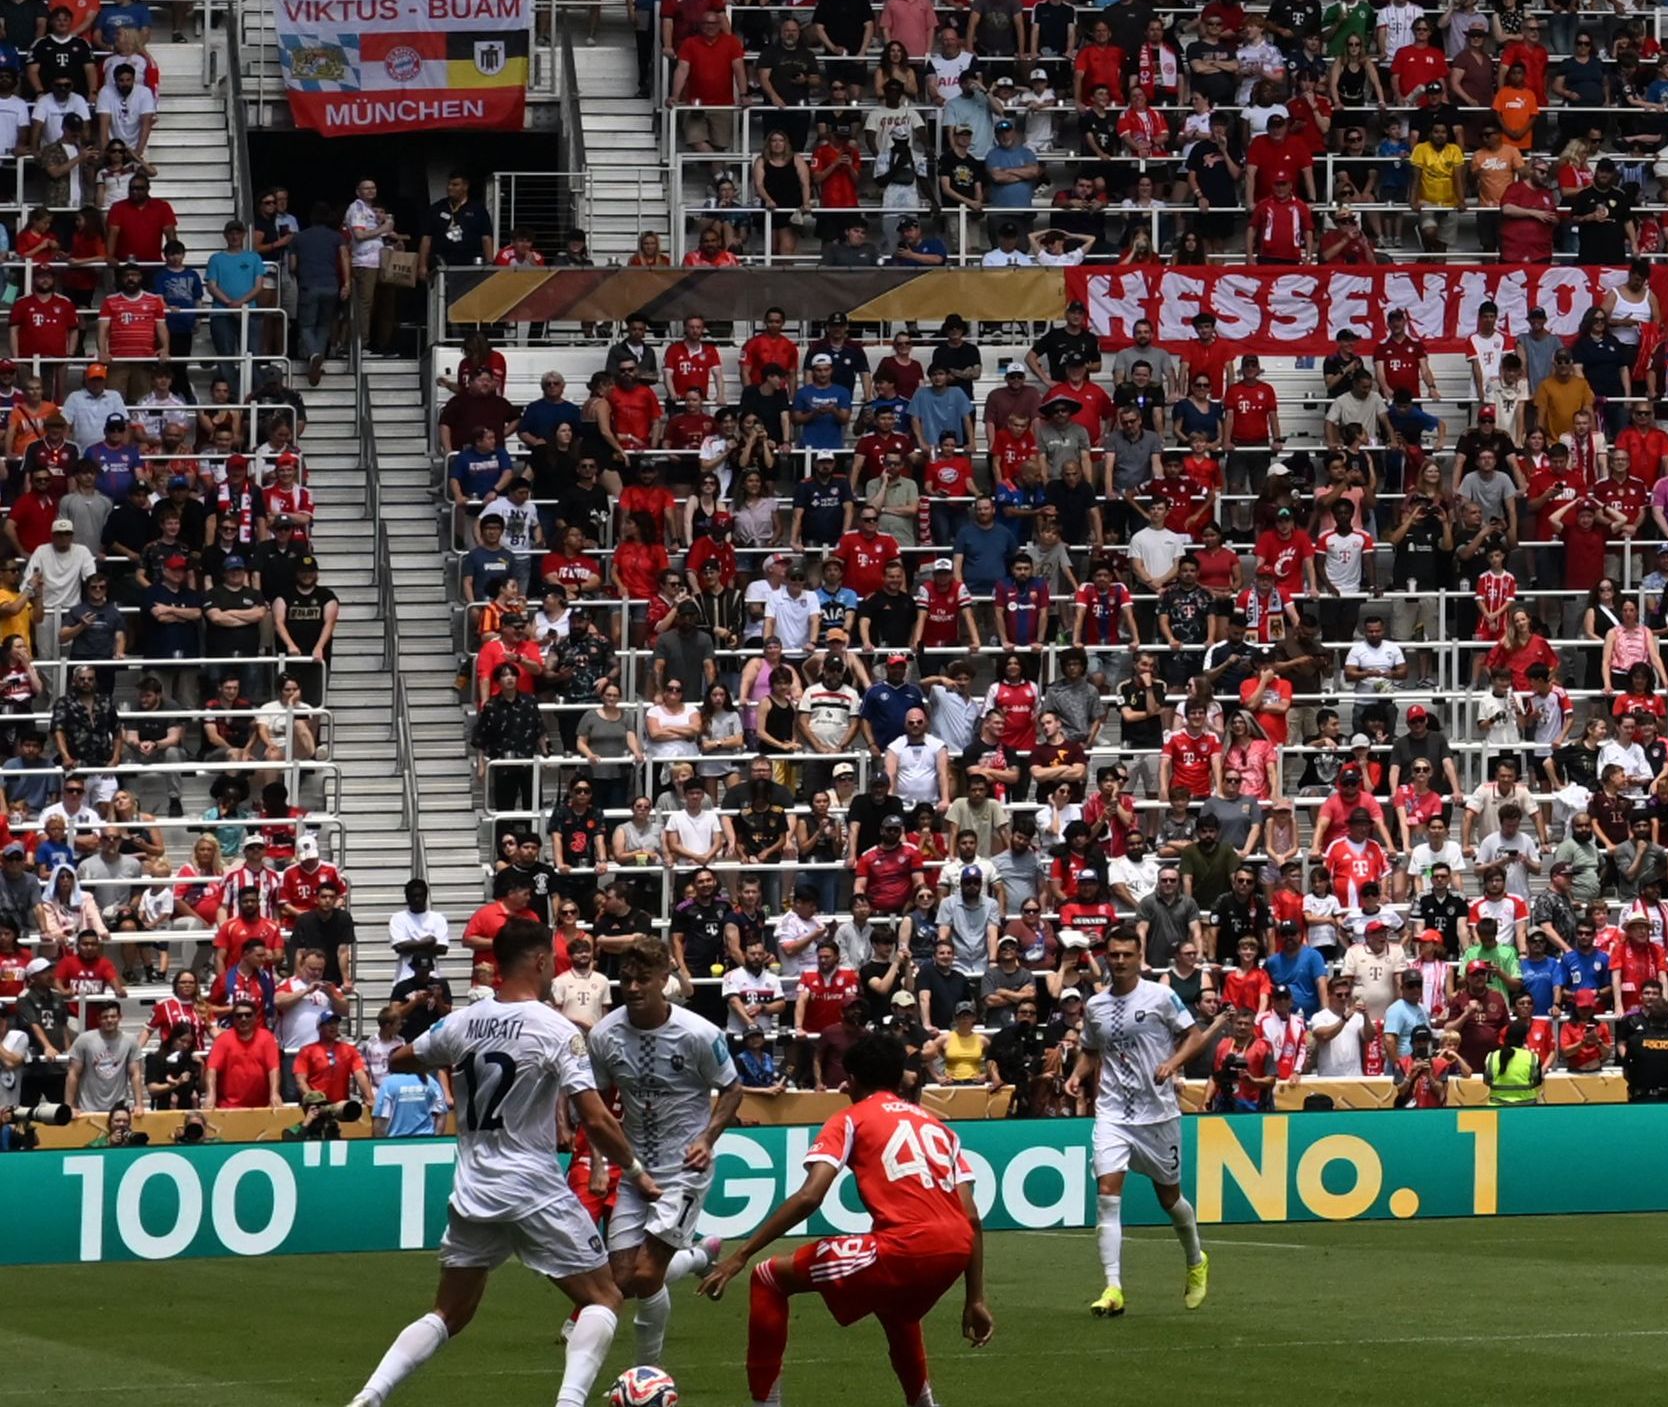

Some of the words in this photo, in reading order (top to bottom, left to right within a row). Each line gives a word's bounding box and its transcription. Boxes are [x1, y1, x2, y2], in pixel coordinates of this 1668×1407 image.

[325, 98, 484, 126] MÜNCHEN
[1086, 266, 1636, 342] HESSENMO
[465, 1017, 524, 1041] MURATI
[453, 1051, 518, 1132] 12
[880, 1119, 958, 1193] 49
[1169, 1145, 1180, 1171] 3
[62, 1140, 348, 1262] 100"
[1197, 1115, 1420, 1224] No.
[1456, 1109, 1499, 1216] 1
[676, 1195, 694, 1229] 7
